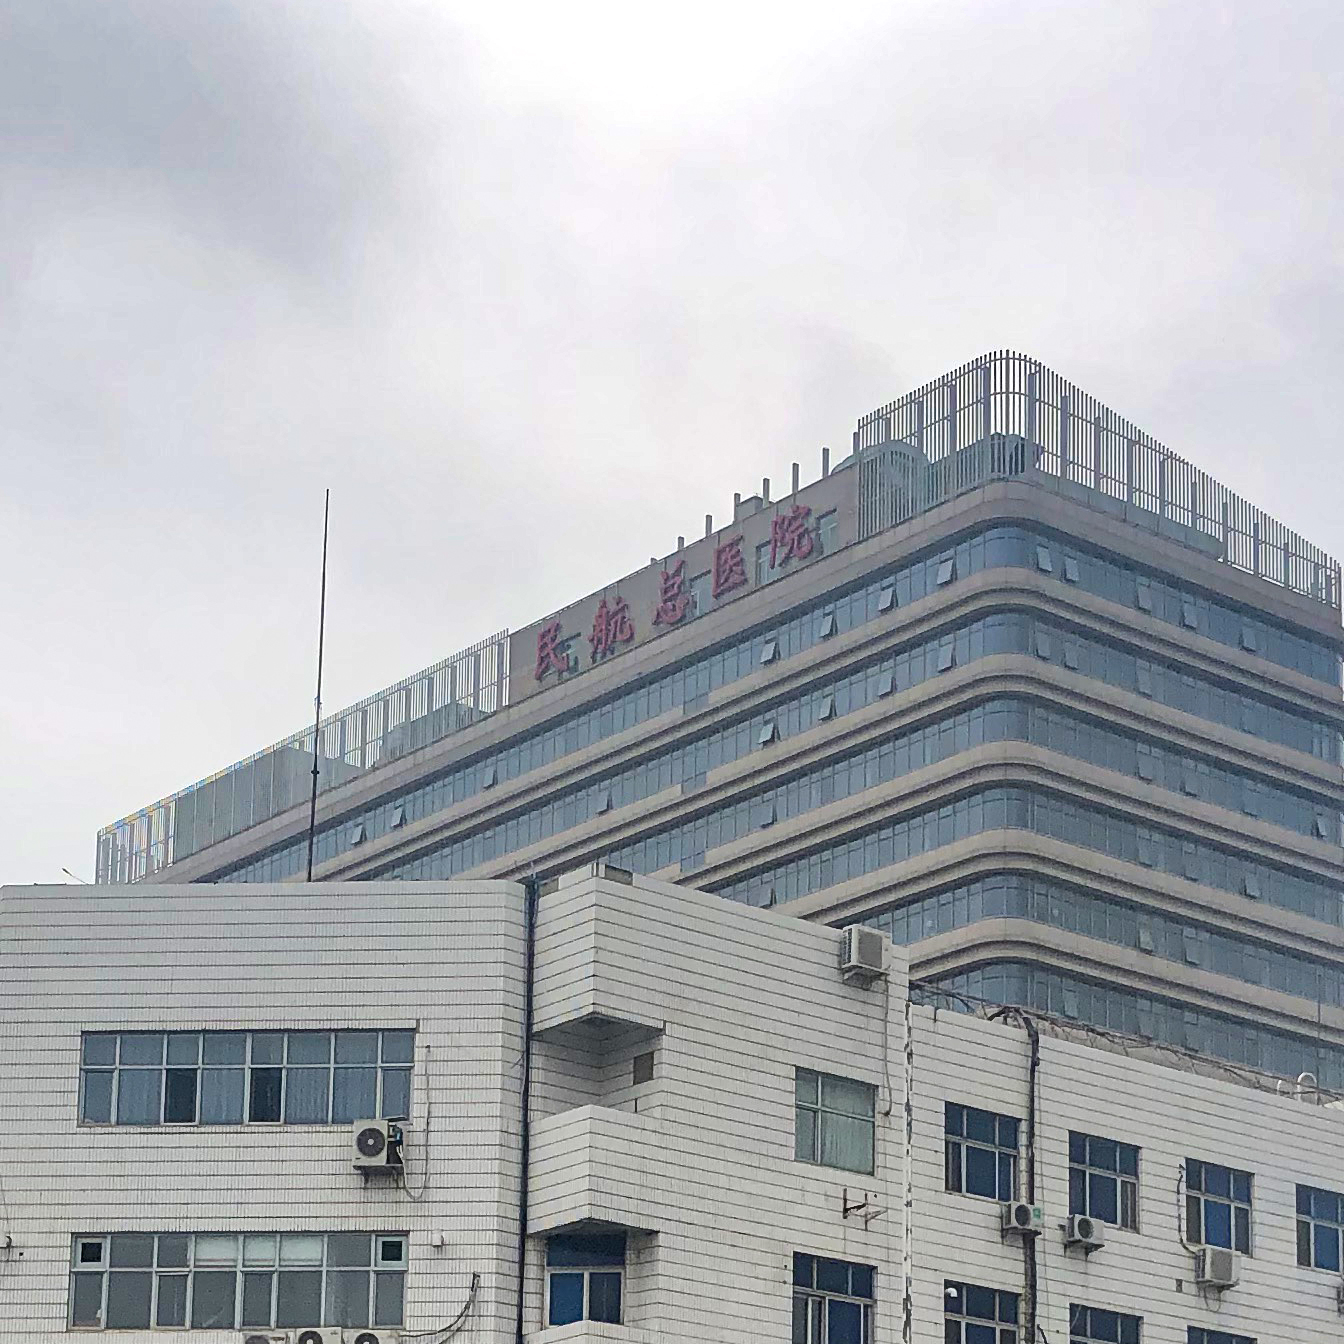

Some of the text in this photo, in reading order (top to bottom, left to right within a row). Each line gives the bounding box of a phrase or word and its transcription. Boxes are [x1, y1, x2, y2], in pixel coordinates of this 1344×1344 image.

[534, 504, 815, 681] 民航总医院
